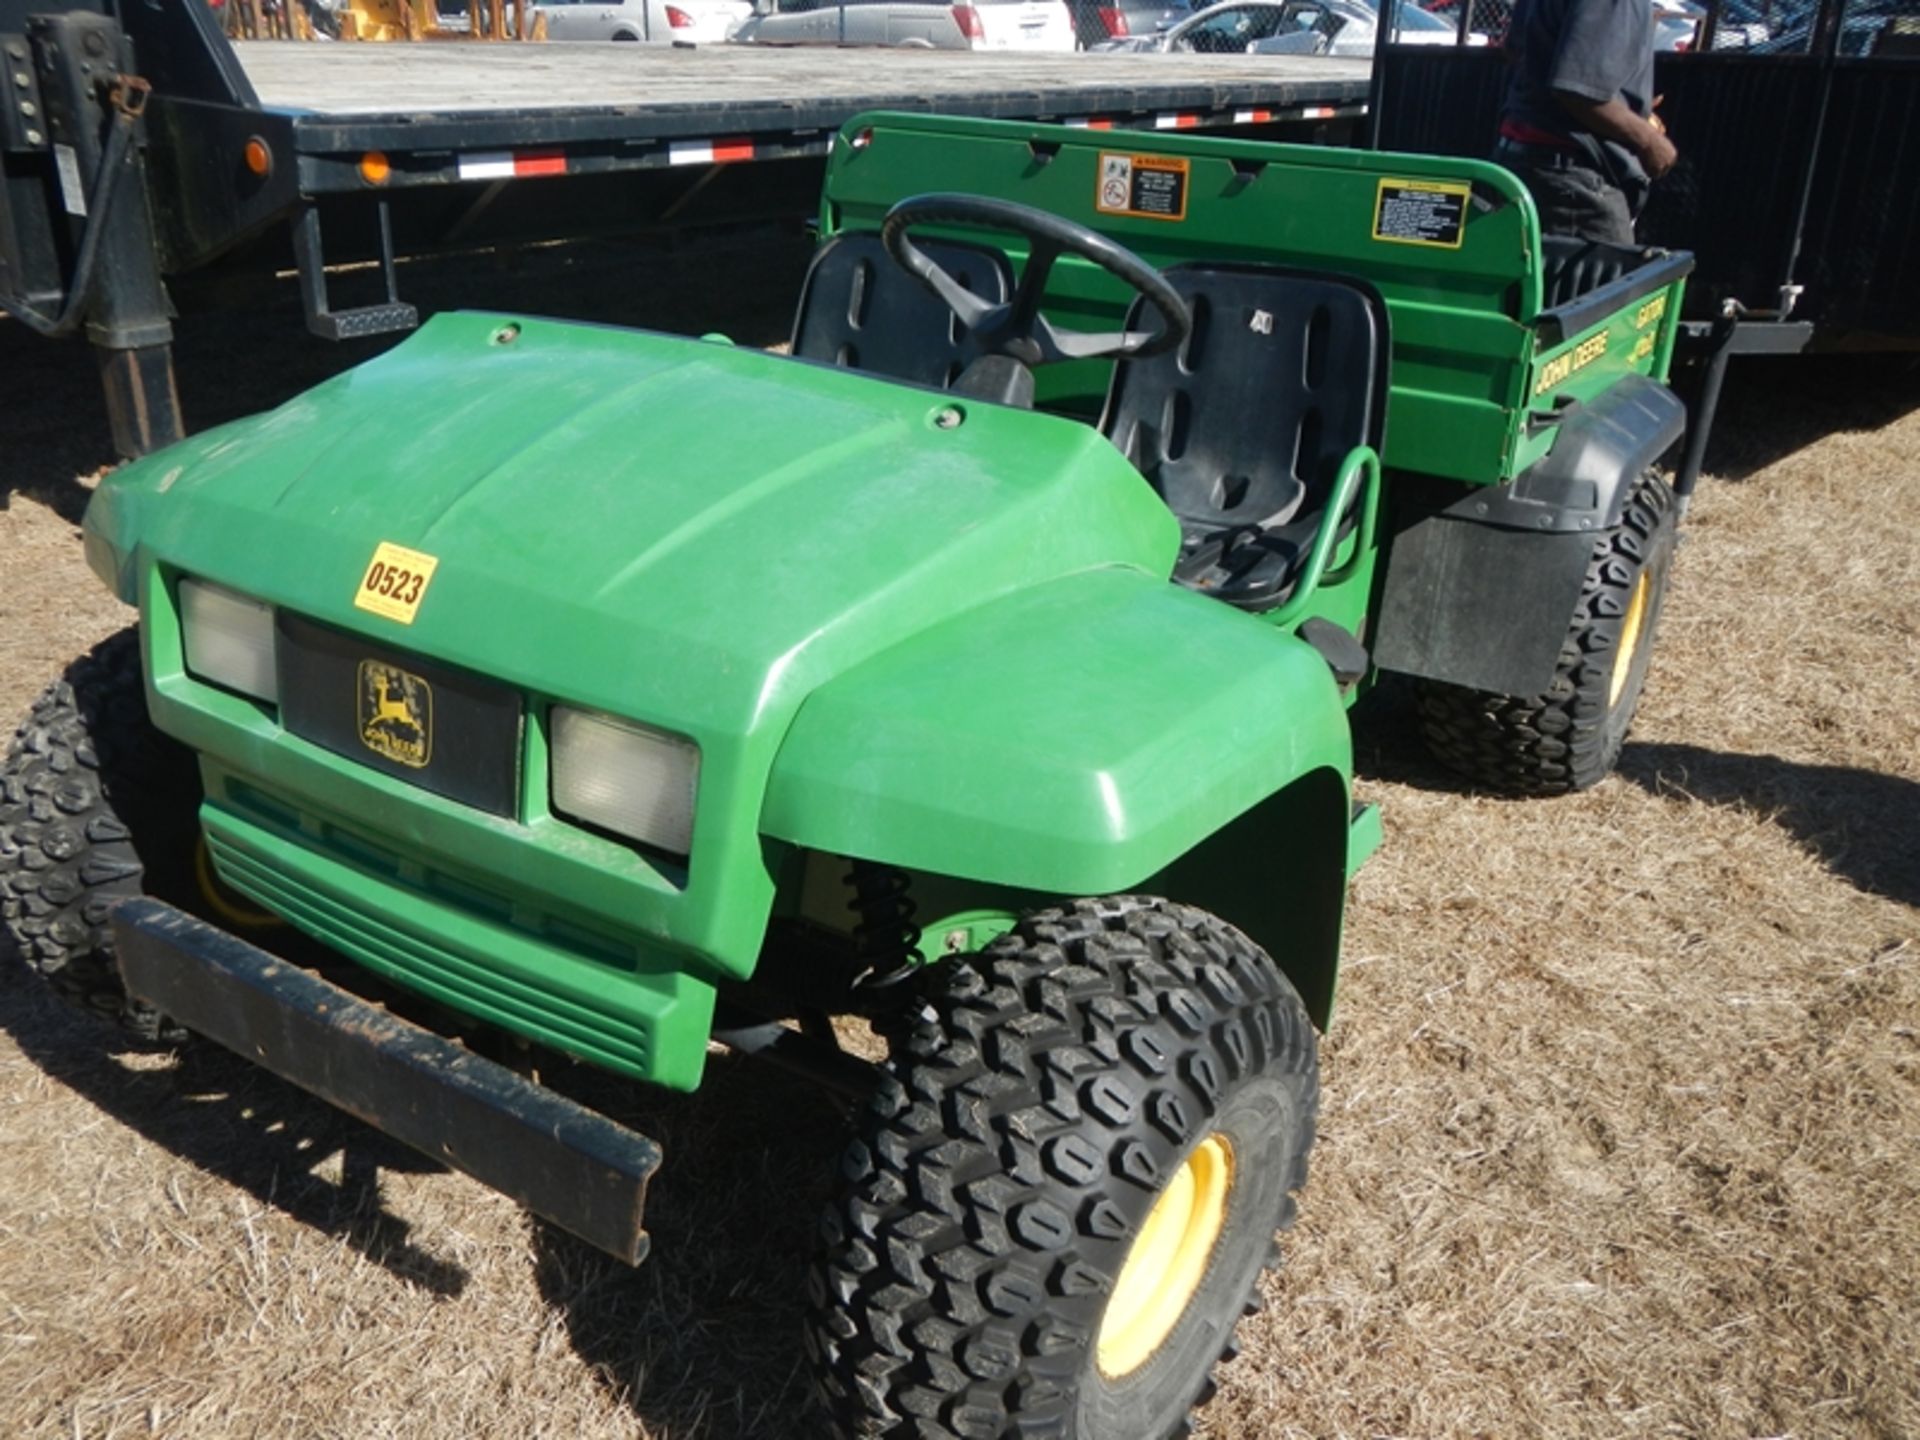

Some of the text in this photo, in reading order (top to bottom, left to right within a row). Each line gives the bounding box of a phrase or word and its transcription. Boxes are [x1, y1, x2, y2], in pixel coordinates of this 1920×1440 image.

[1535, 351, 1572, 396] JOHN
[1572, 328, 1610, 372] DEERE
[366, 561, 424, 605] 0523
